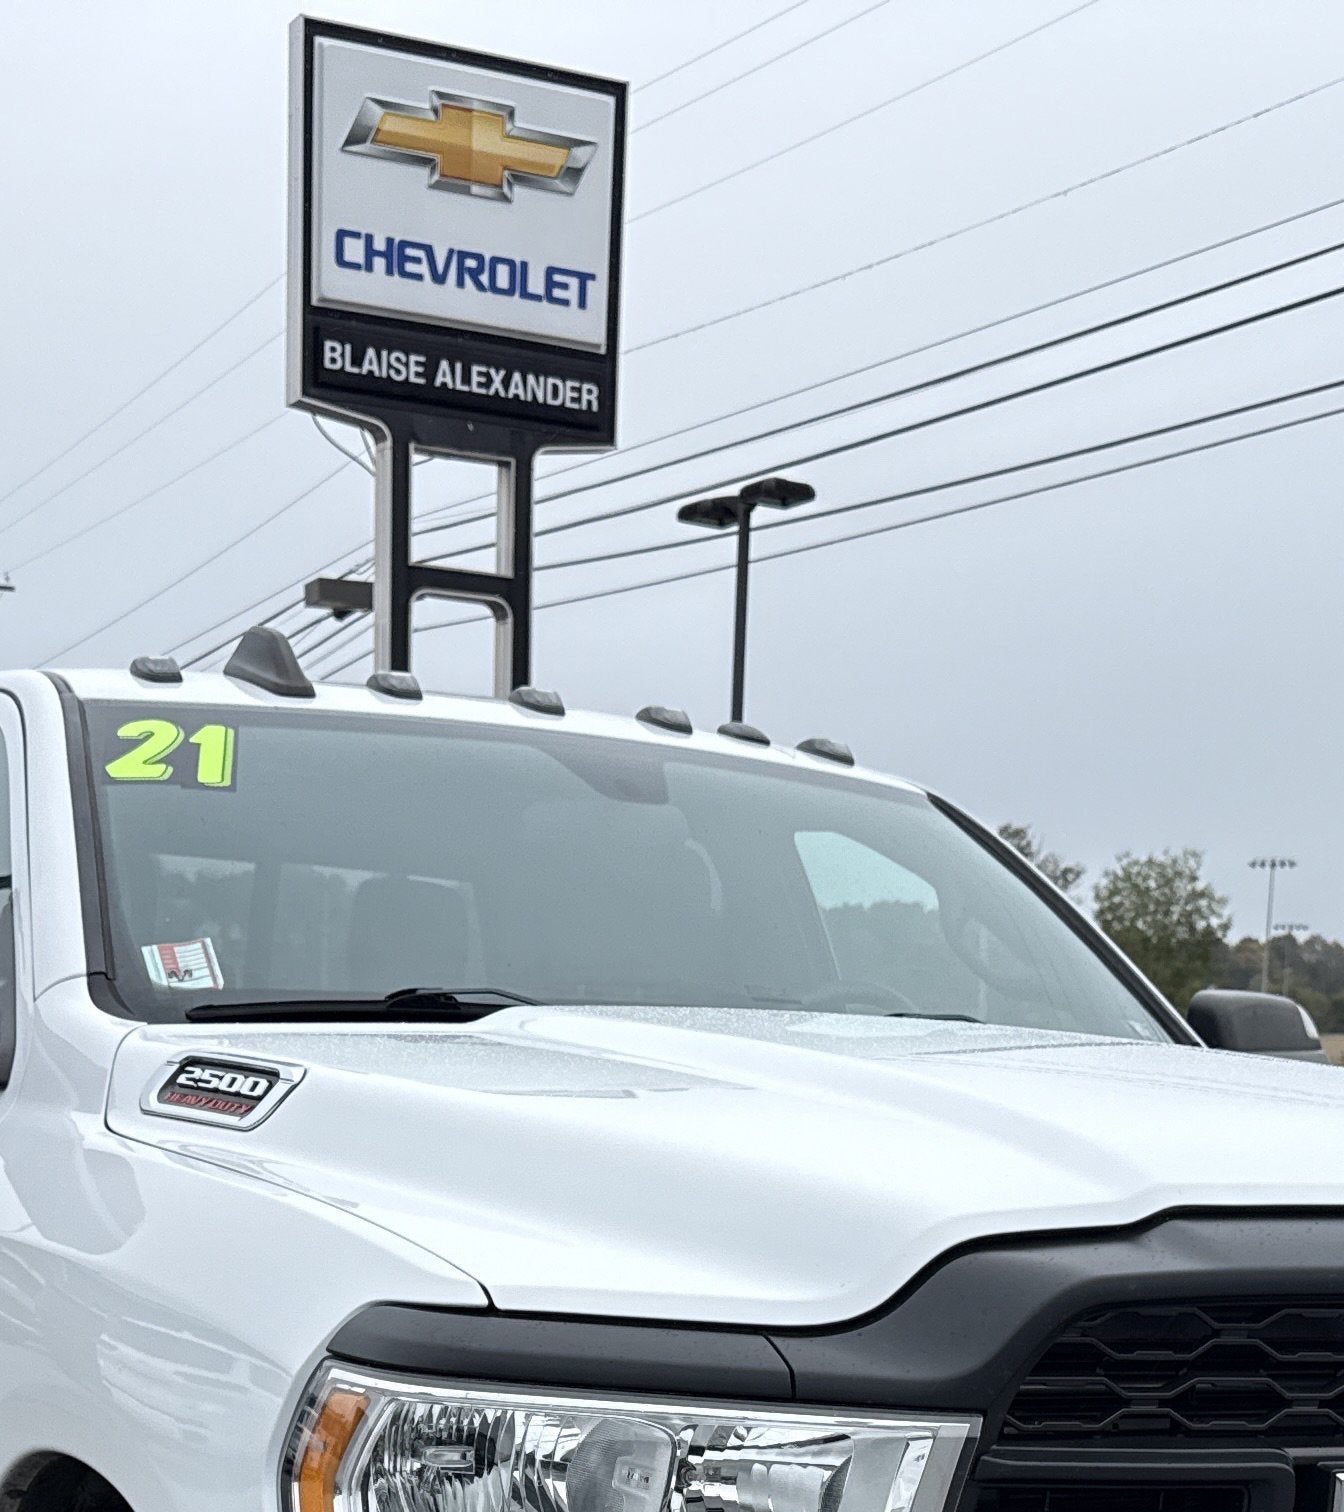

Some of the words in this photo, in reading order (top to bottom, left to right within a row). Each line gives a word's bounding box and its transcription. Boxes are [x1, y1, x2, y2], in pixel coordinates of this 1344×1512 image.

[335, 228, 596, 310] CHEVROLET
[323, 340, 427, 384] BLAISE
[435, 359, 599, 412] ALEXANDER
[105, 719, 235, 787] 21
[164, 1091, 209, 1108] HEAVY
[206, 1099, 253, 1115] DUTY
[175, 1066, 270, 1097] 2500
